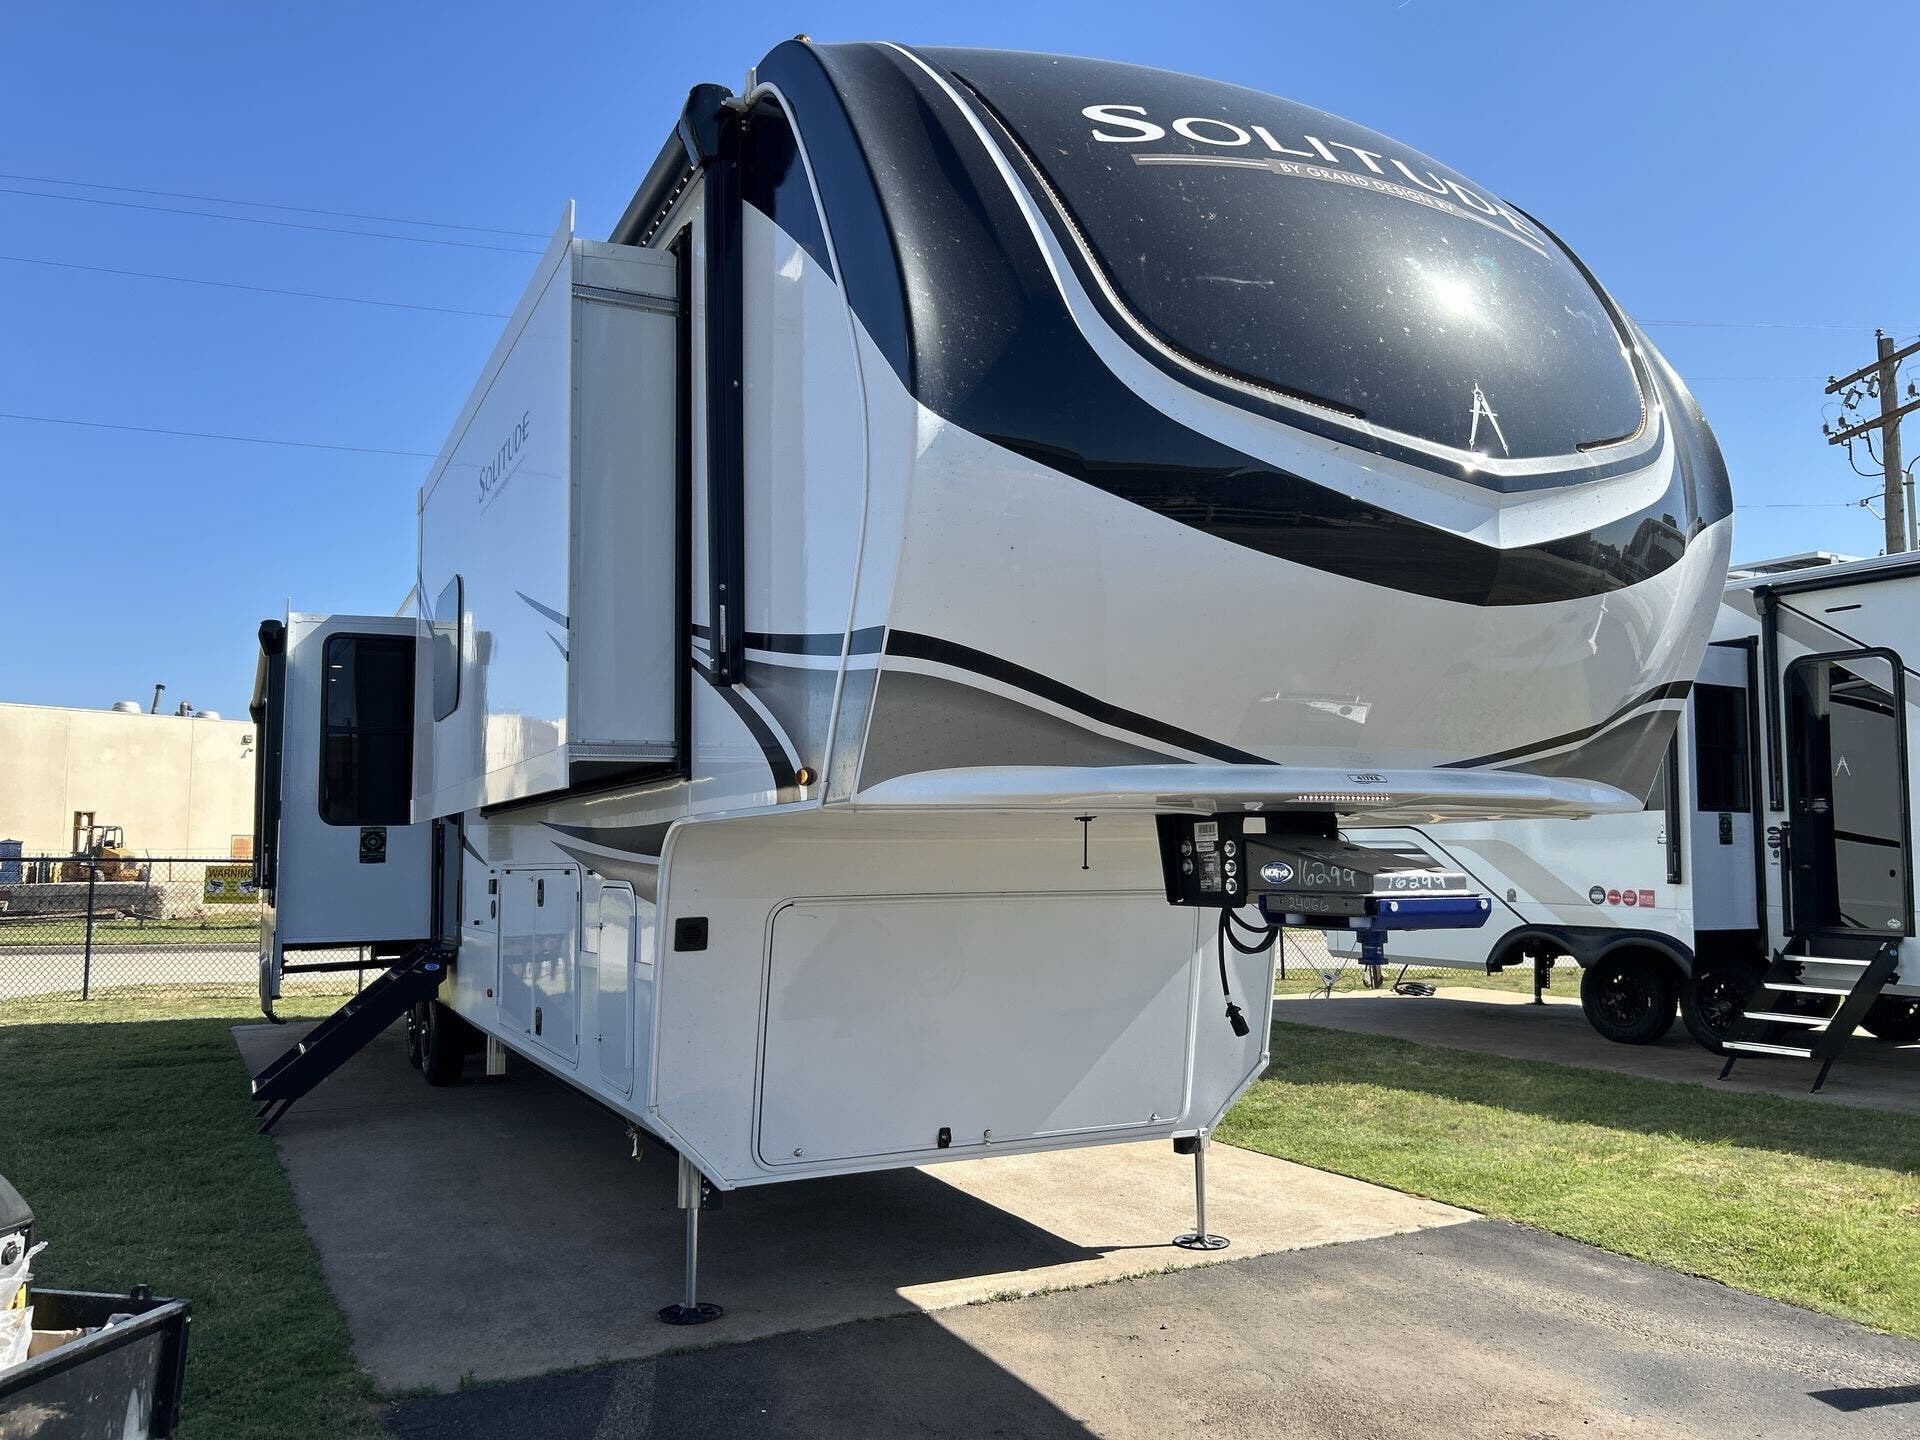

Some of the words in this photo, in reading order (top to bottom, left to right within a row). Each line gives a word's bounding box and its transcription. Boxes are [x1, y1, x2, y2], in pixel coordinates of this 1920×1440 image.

[1082, 104, 1545, 246] SOLITUDE
[1279, 162, 1301, 173] BY
[1306, 166, 1369, 187] GRAND
[1373, 179, 1435, 206] DESIGN
[478, 409, 530, 504] SOLITUDE
[208, 868, 254, 878] WARNING
[1298, 858, 1356, 887] 16299
